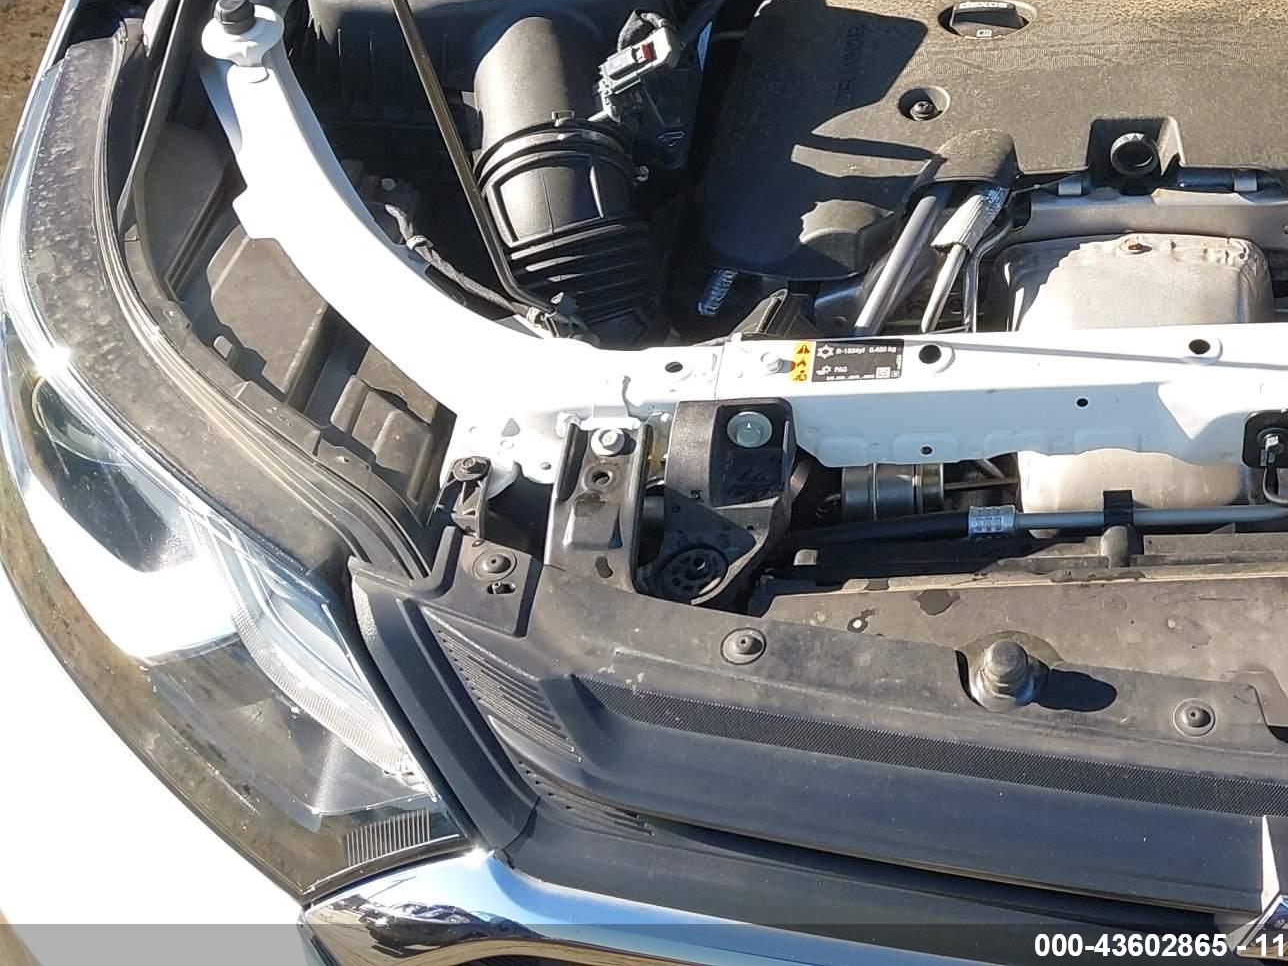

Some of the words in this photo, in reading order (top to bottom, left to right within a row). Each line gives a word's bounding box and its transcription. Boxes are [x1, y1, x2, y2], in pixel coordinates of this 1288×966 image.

[959, 1, 1008, 9] dexos
[836, 347, 865, 355] R-1234yf
[887, 346, 897, 354] kg
